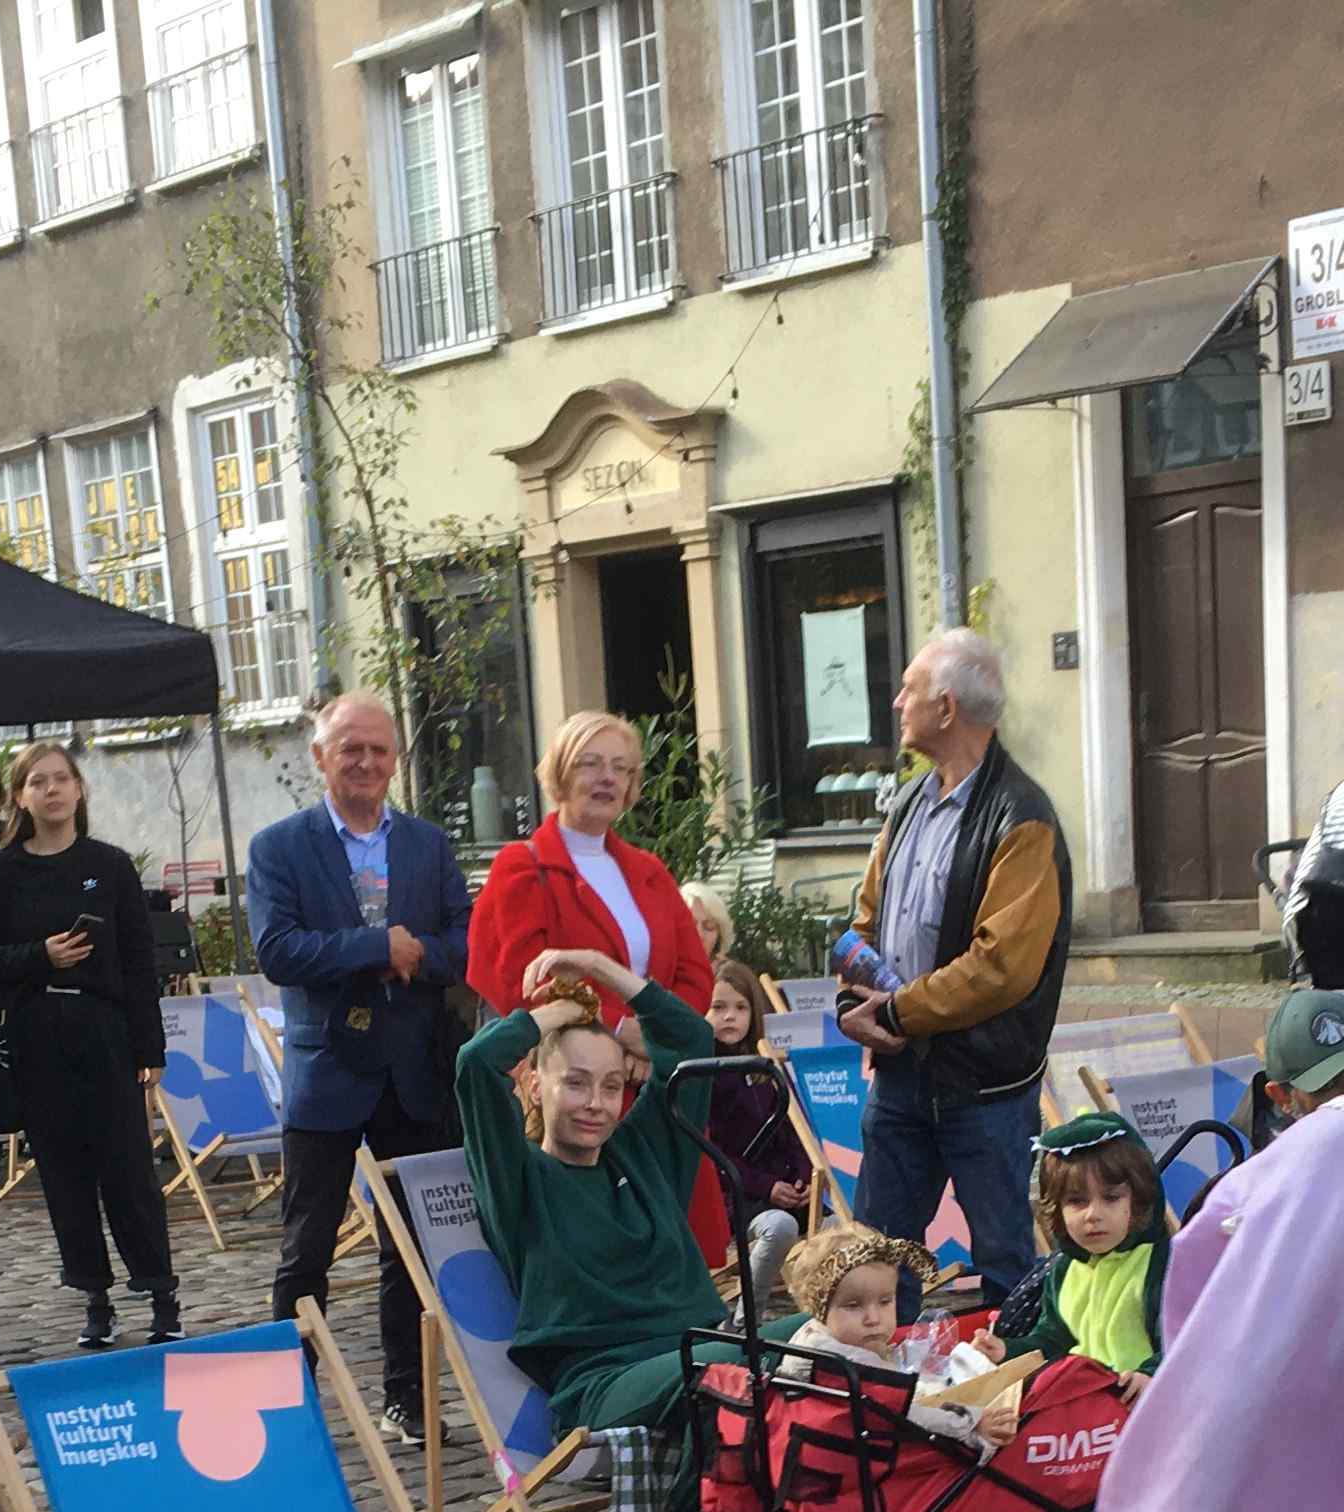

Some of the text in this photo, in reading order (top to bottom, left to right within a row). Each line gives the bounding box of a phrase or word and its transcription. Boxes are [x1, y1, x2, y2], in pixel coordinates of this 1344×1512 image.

[1288, 366, 1325, 406] 3/4
[46, 1399, 138, 1427] Instytut
[53, 1423, 134, 1446] kultury
[58, 1440, 158, 1467] miejskiej
